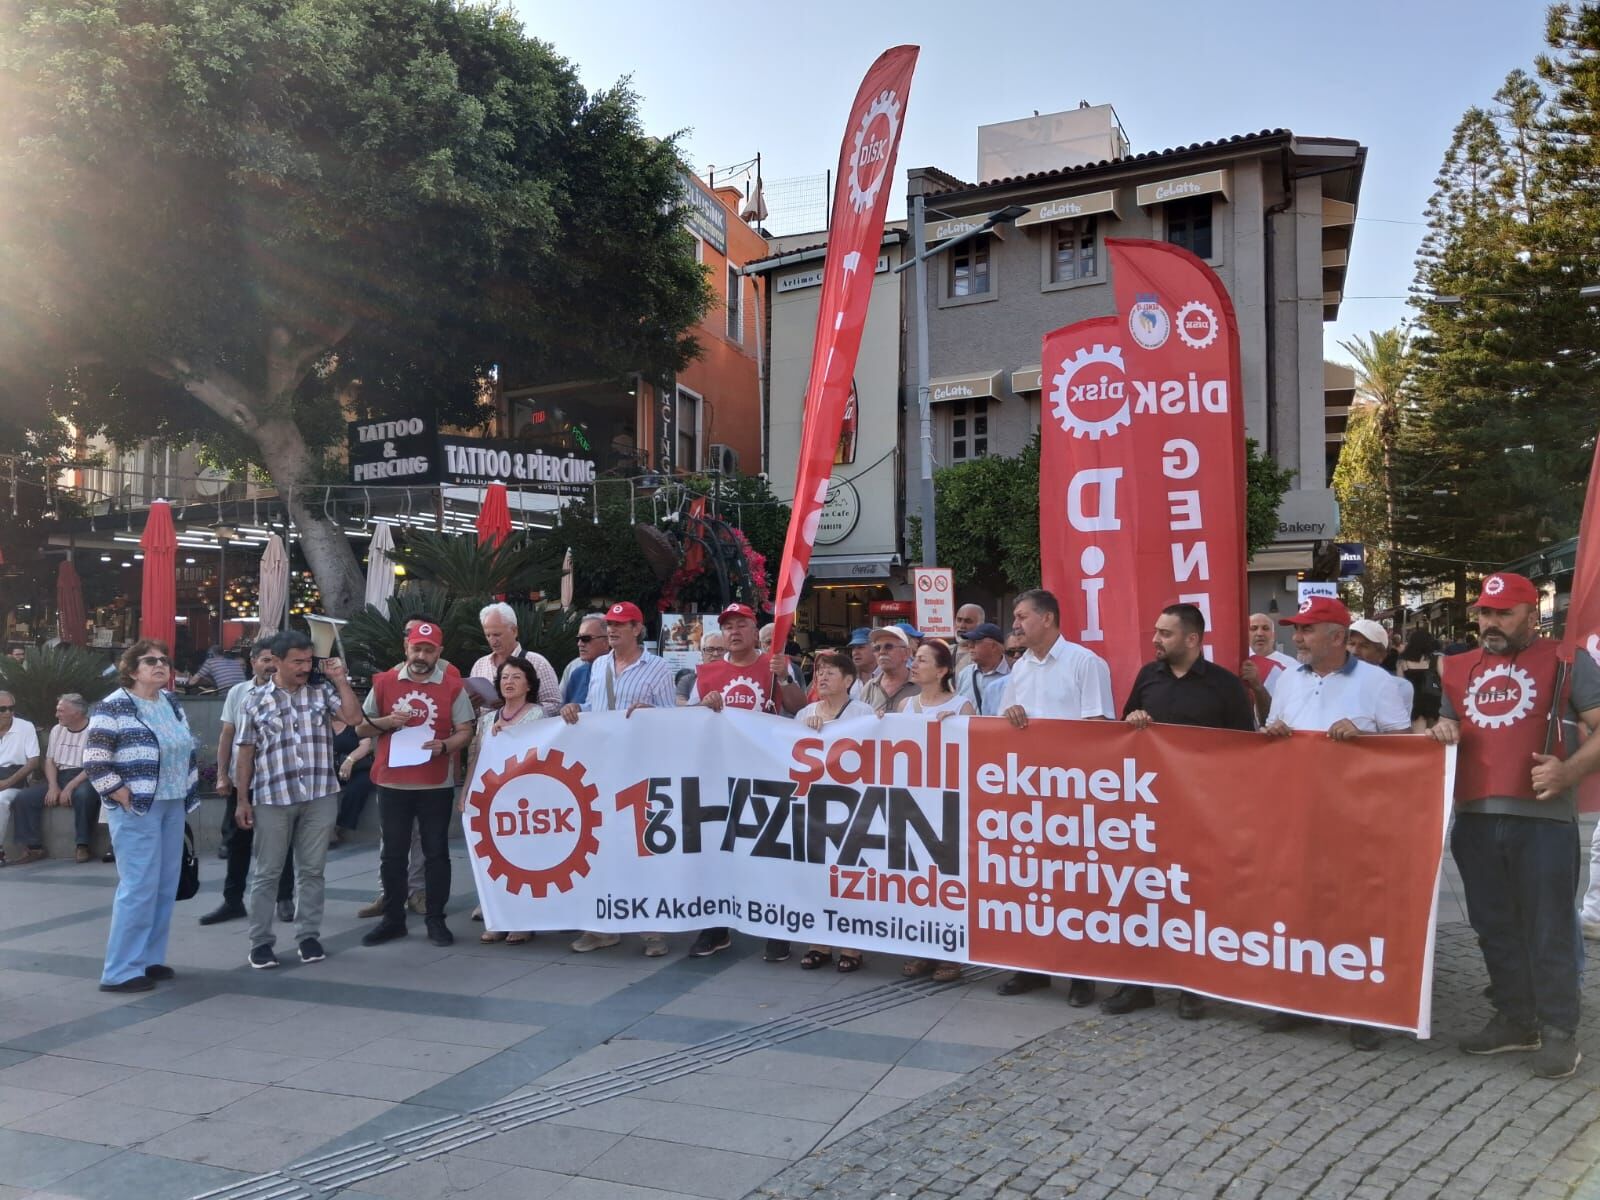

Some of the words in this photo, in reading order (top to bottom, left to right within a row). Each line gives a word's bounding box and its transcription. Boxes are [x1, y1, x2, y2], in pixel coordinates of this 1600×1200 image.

[860, 133, 888, 166] DİSK
[1156, 182, 1201, 200] GeLatte
[1039, 201, 1082, 219] GeLatte
[934, 385, 973, 400] GeLatte
[357, 418, 424, 443] TATTOO
[383, 441, 397, 458] &
[444, 445, 512, 478] TATTOO
[513, 452, 526, 479] &
[354, 456, 428, 481] PIERCING
[1279, 522, 1325, 534] Bakery
[789, 721, 960, 797] şanlı
[976, 752, 1158, 803] ekmek
[495, 798, 575, 836] DİSK
[976, 801, 1157, 853] adalet
[829, 864, 967, 911] izinde
[978, 841, 1191, 906] hürriyet
[596, 893, 650, 920] DİSK
[655, 895, 743, 919] Akdeniz
[747, 900, 815, 933] Bölge
[823, 909, 965, 952] Temsilciliği
[978, 893, 1386, 984] mücadelesine!
